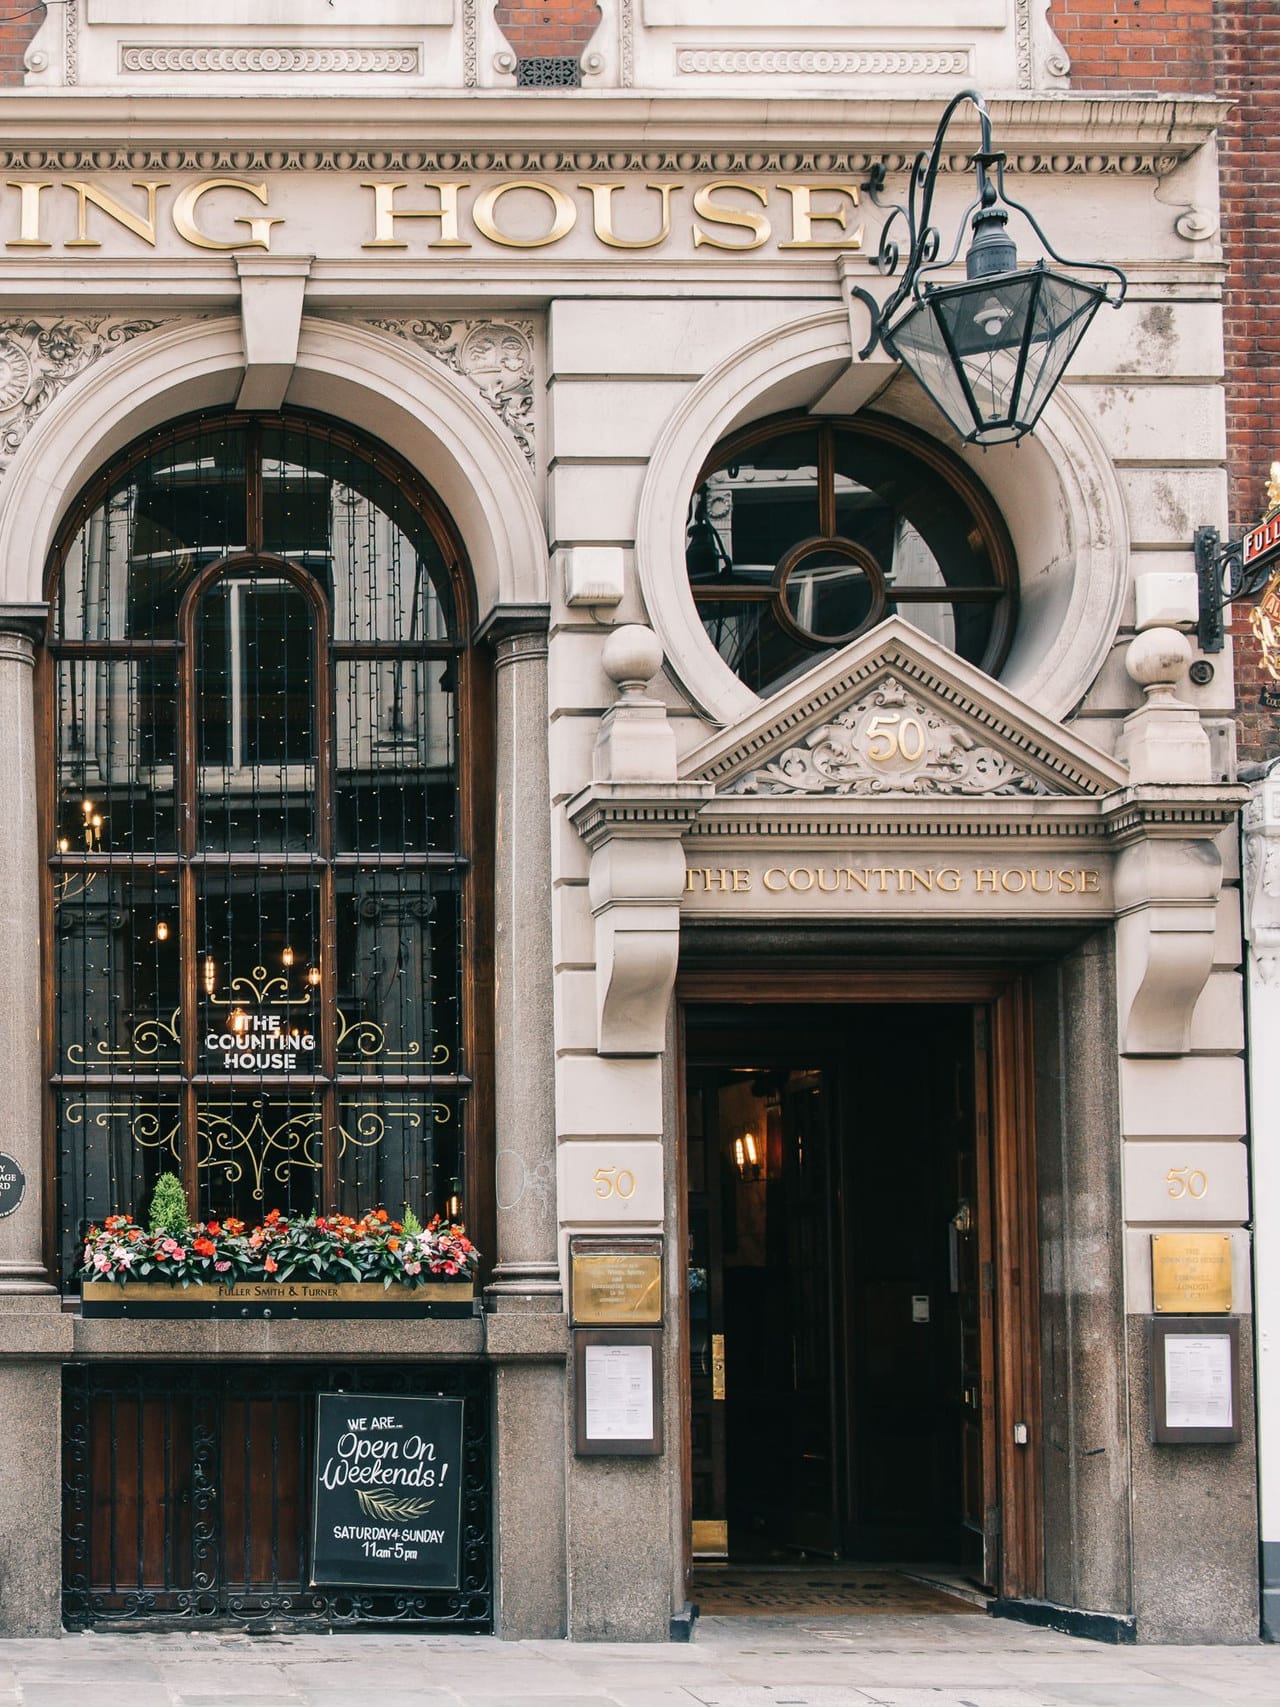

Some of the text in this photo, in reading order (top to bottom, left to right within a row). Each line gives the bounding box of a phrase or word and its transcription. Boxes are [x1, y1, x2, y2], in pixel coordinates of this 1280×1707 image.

[359, 180, 864, 250] HOUSE
[865, 713, 925, 761] 50
[684, 867, 1101, 894] THE COUNTING HOUSE
[240, 1015, 281, 1031] THE
[205, 1034, 316, 1050] COUNTING
[224, 1053, 296, 1069] HOUSE
[592, 1168, 638, 1200] 50
[1166, 1167, 1209, 1201] 50
[218, 1286, 338, 1297] FULLER SMITH & TURNER
[347, 1418, 368, 1431] WE
[337, 1432, 437, 1465] Open On
[333, 1525, 394, 1541] SATURDAY
[401, 1528, 445, 1544] SUNDAY
